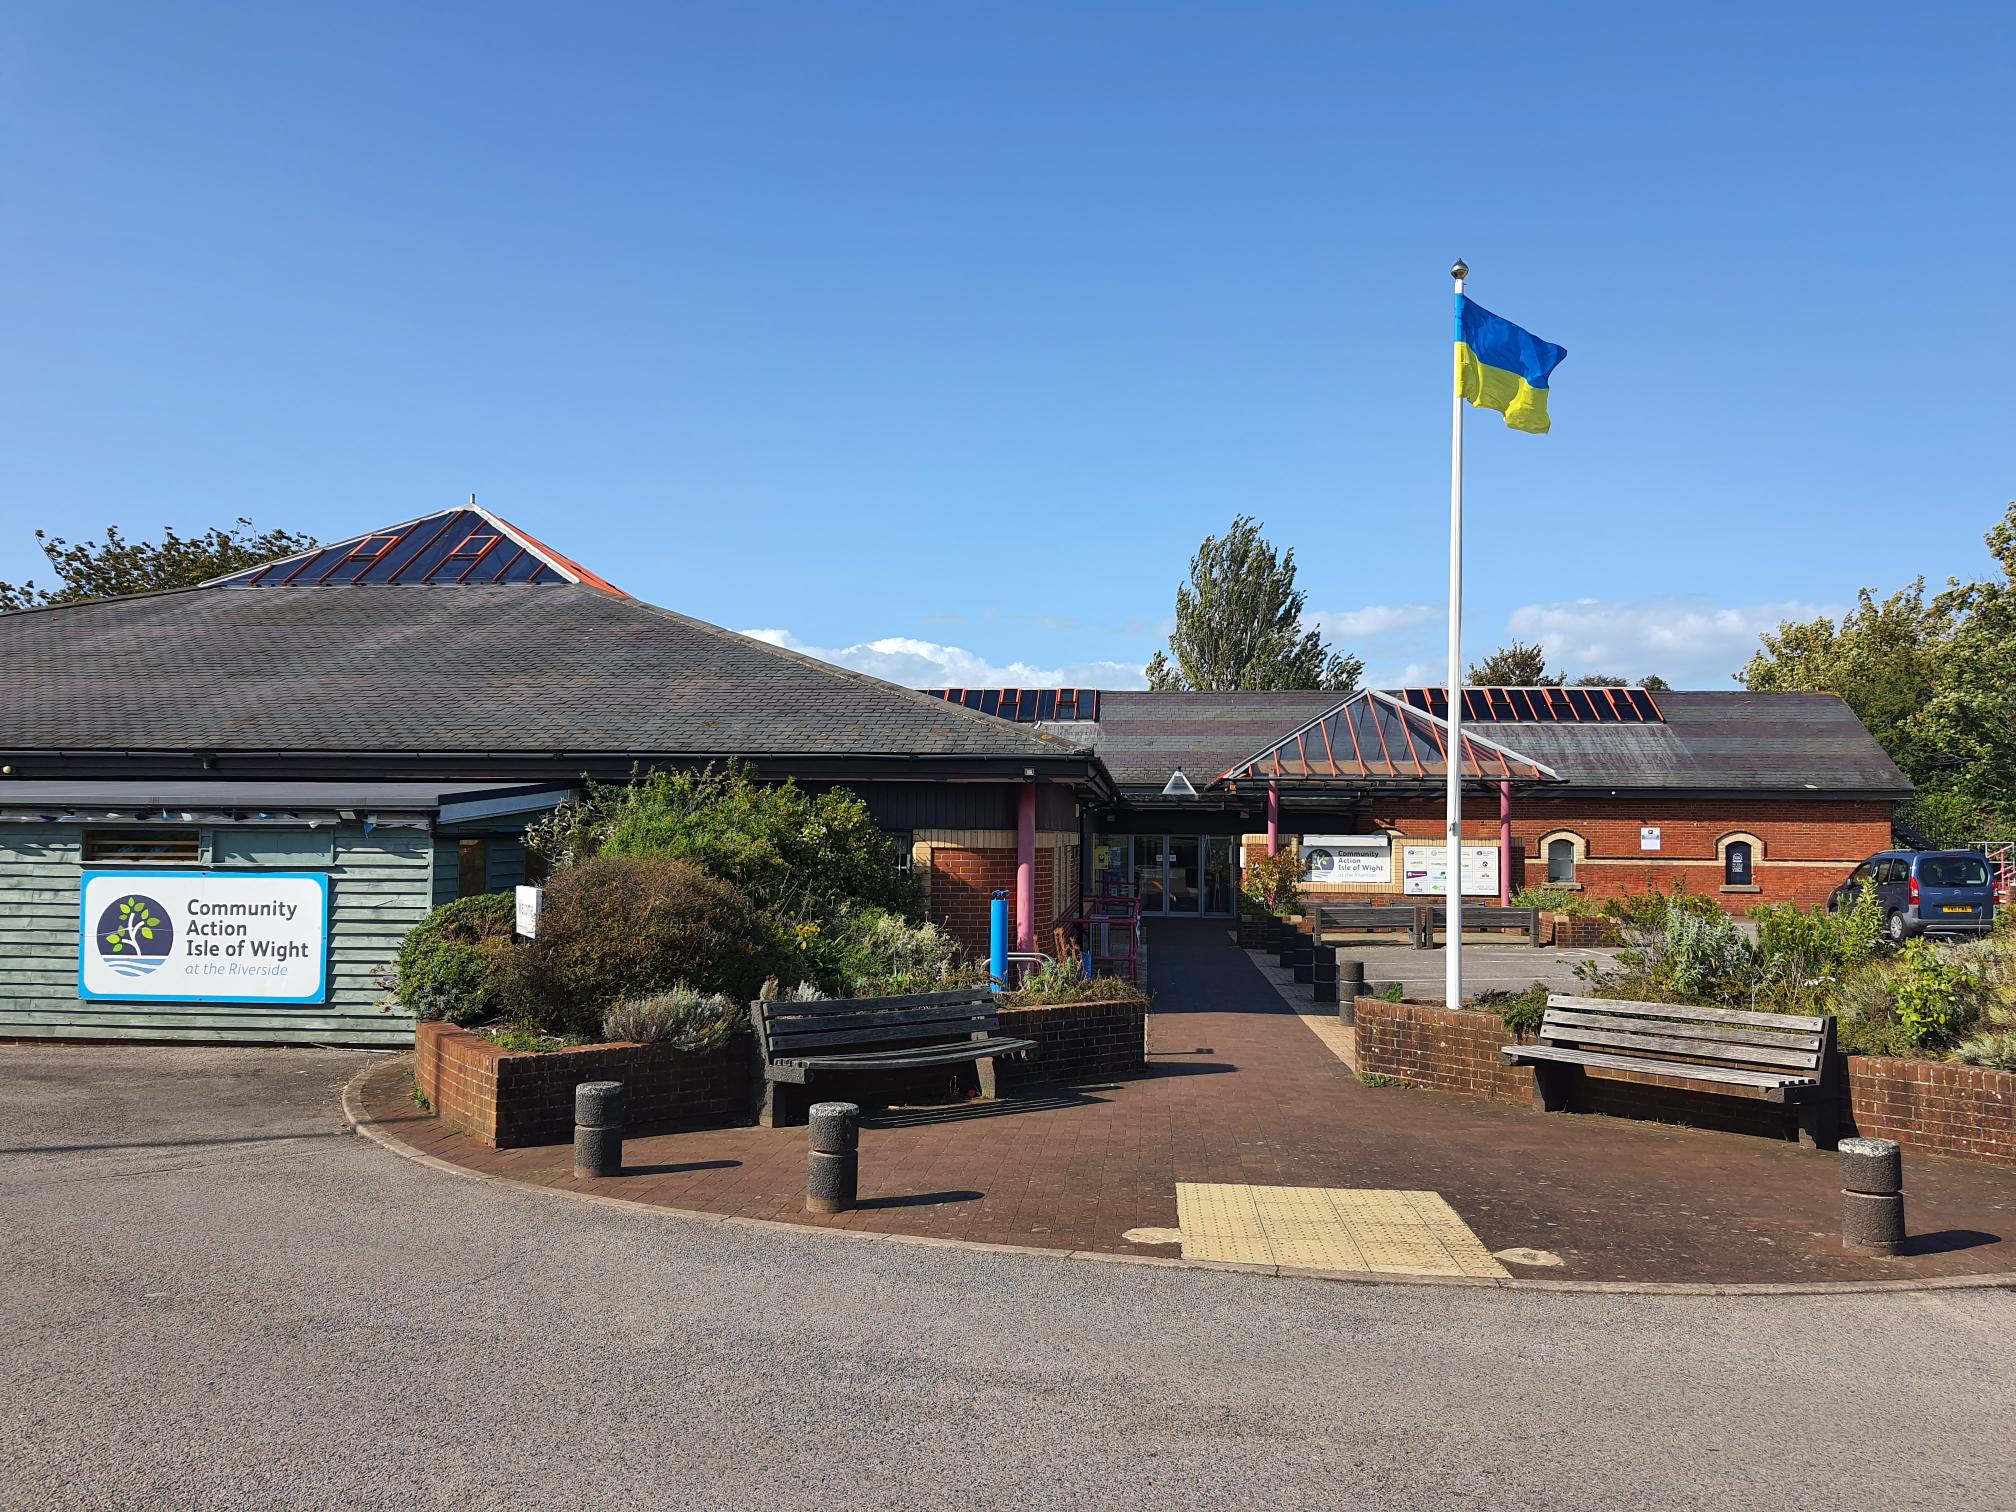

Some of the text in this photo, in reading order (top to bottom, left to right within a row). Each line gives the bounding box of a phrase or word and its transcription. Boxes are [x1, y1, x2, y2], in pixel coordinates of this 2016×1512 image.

[1338, 850, 1379, 858] Community
[187, 899, 298, 921] Community
[186, 920, 247, 936] Action
[186, 940, 309, 962] Isle of Wight
[185, 963, 288, 976] at the Riverside
